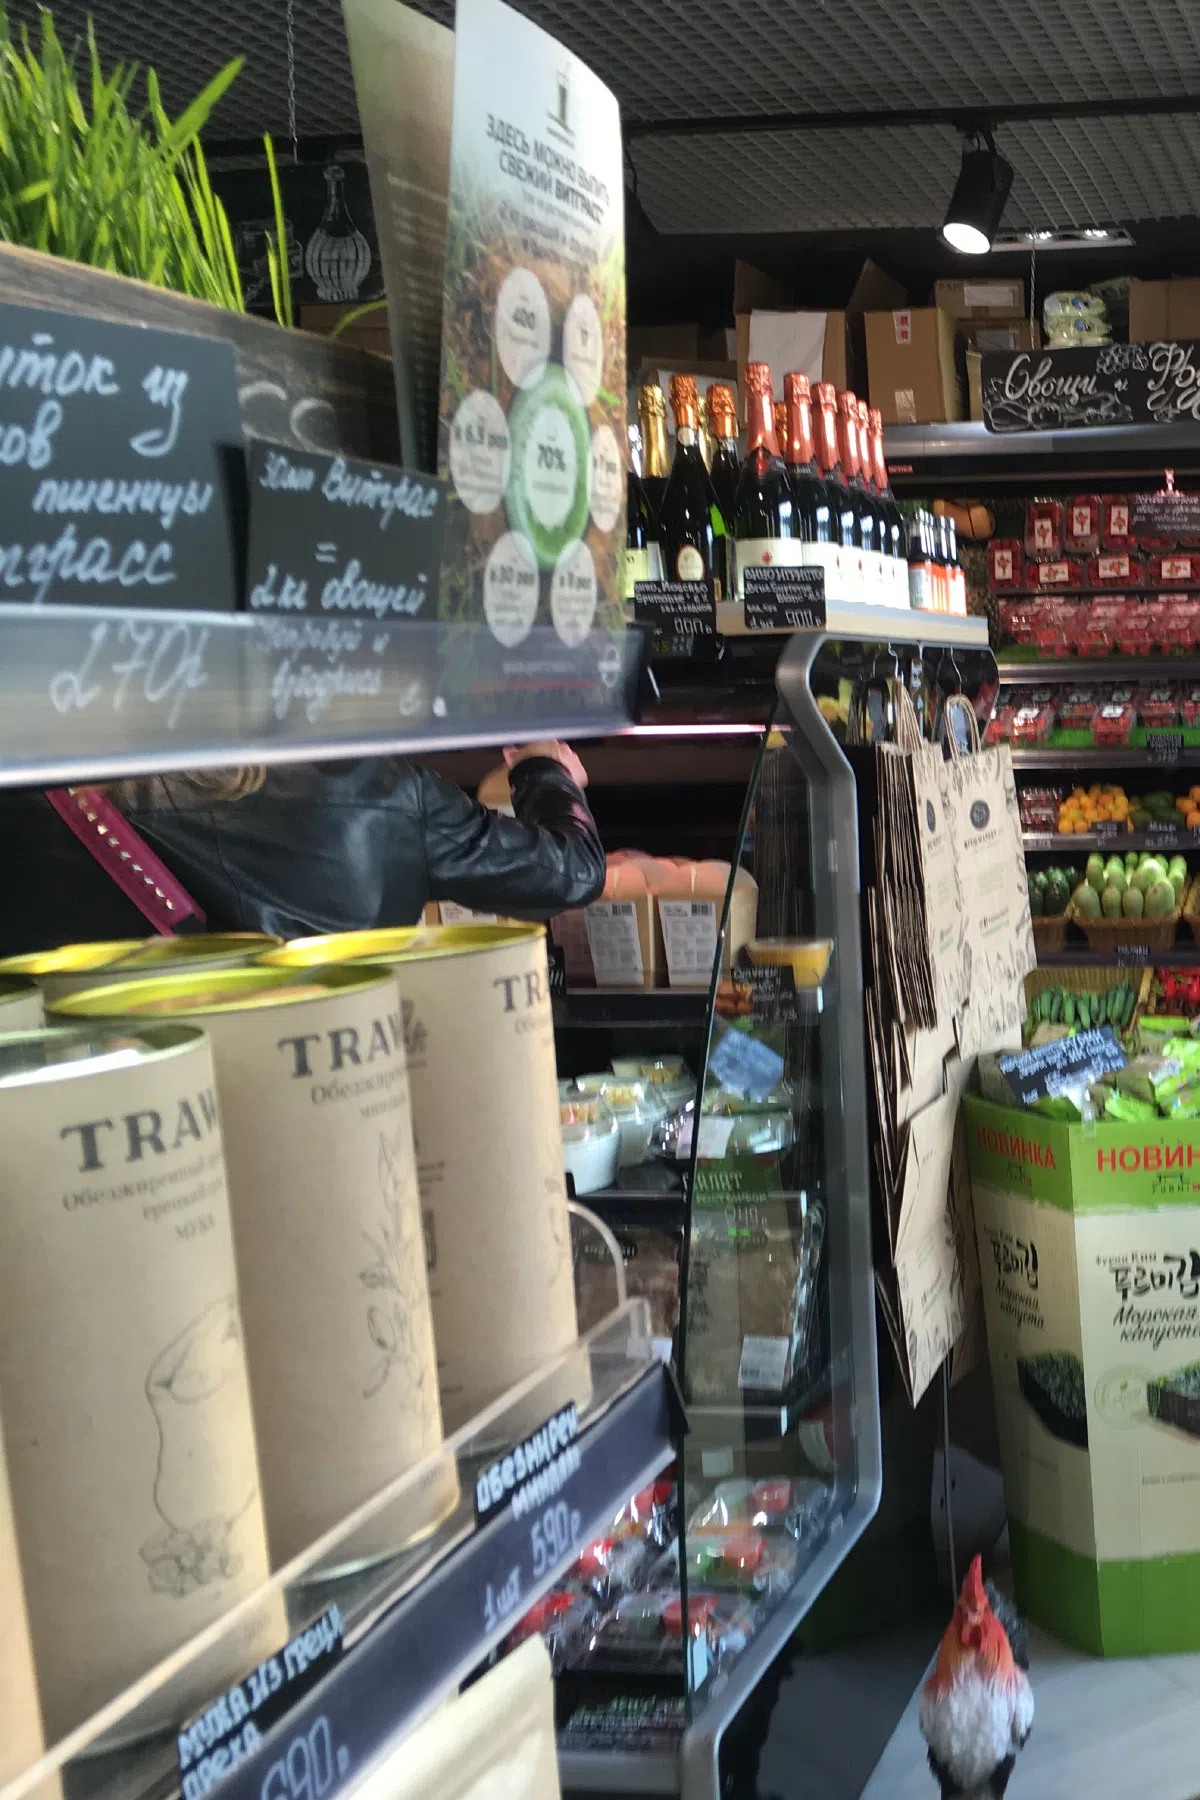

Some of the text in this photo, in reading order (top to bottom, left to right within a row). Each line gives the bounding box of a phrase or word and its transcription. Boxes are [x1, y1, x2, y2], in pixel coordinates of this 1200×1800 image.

[1004, 352, 1097, 405] Овощи
[976, 1126, 1057, 1172] НОВИНКА
[1112, 1303, 1198, 1331] Морская
